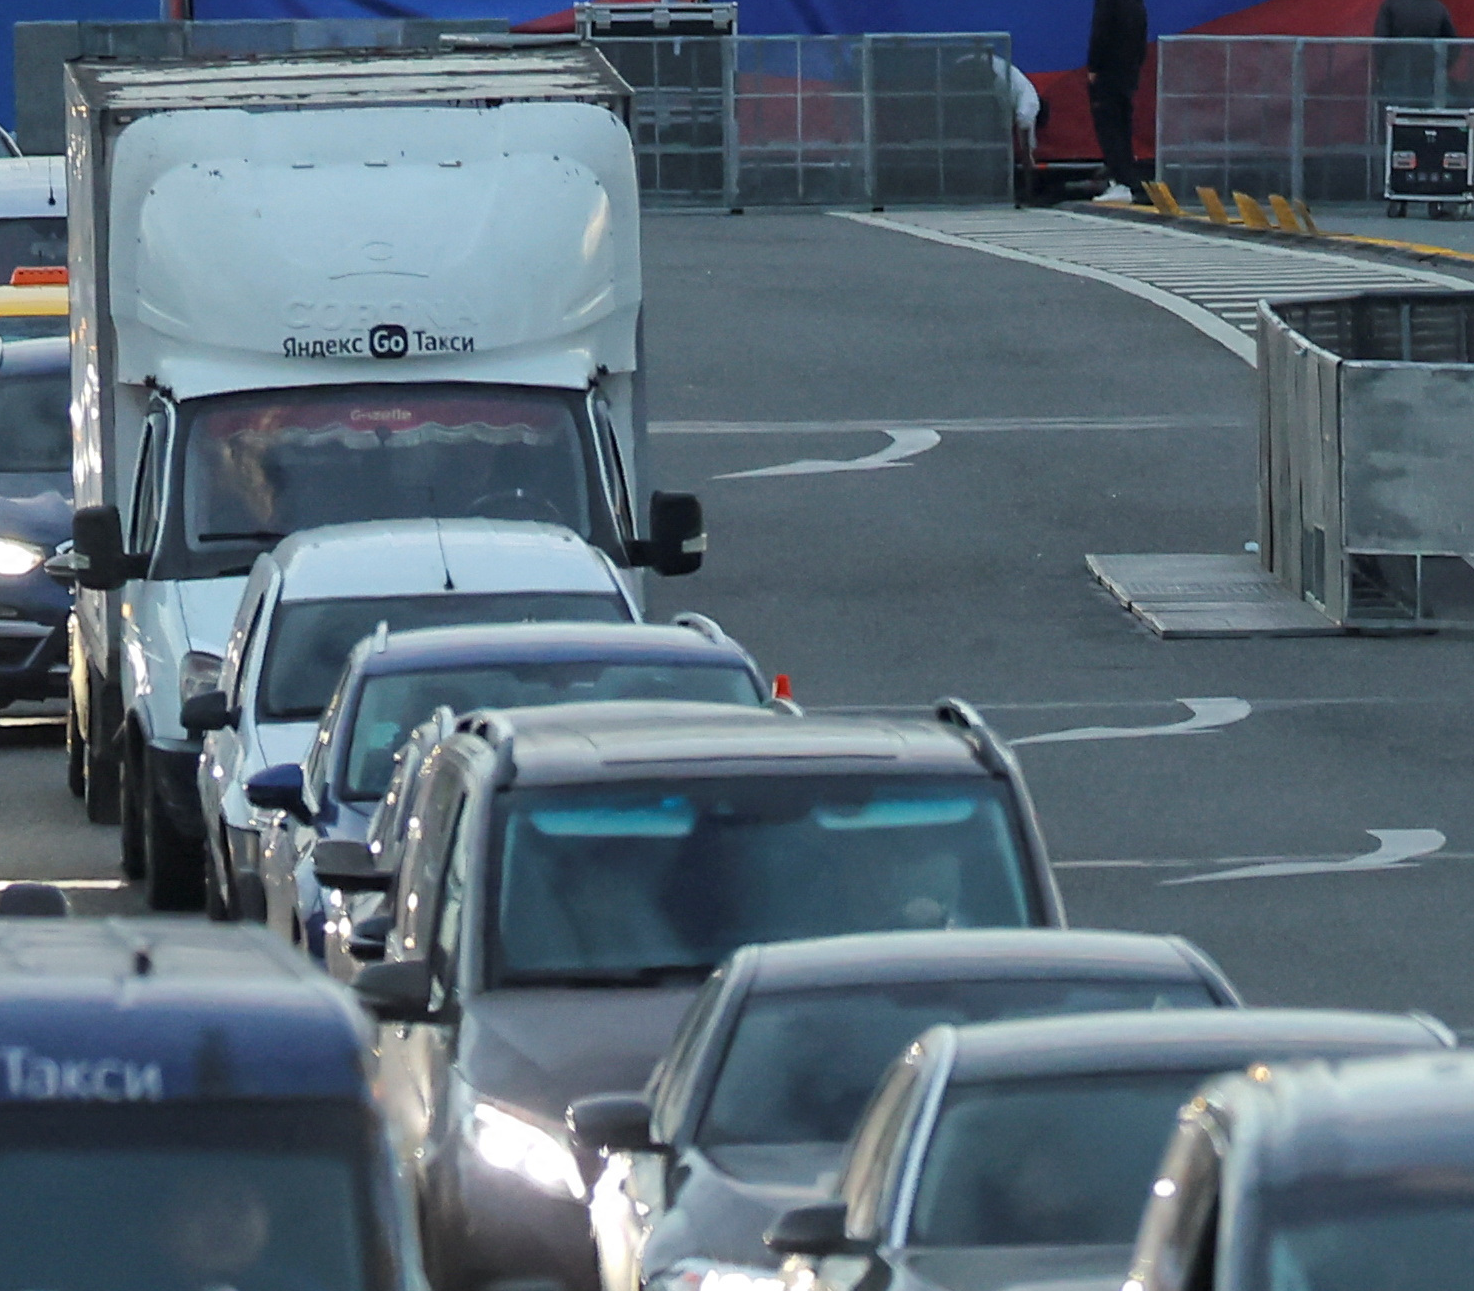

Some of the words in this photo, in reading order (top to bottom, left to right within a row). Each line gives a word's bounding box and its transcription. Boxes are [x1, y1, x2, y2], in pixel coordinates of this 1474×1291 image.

[283, 337, 363, 358] Яндекс
[373, 329, 407, 355] Go
[413, 330, 475, 353] Такси
